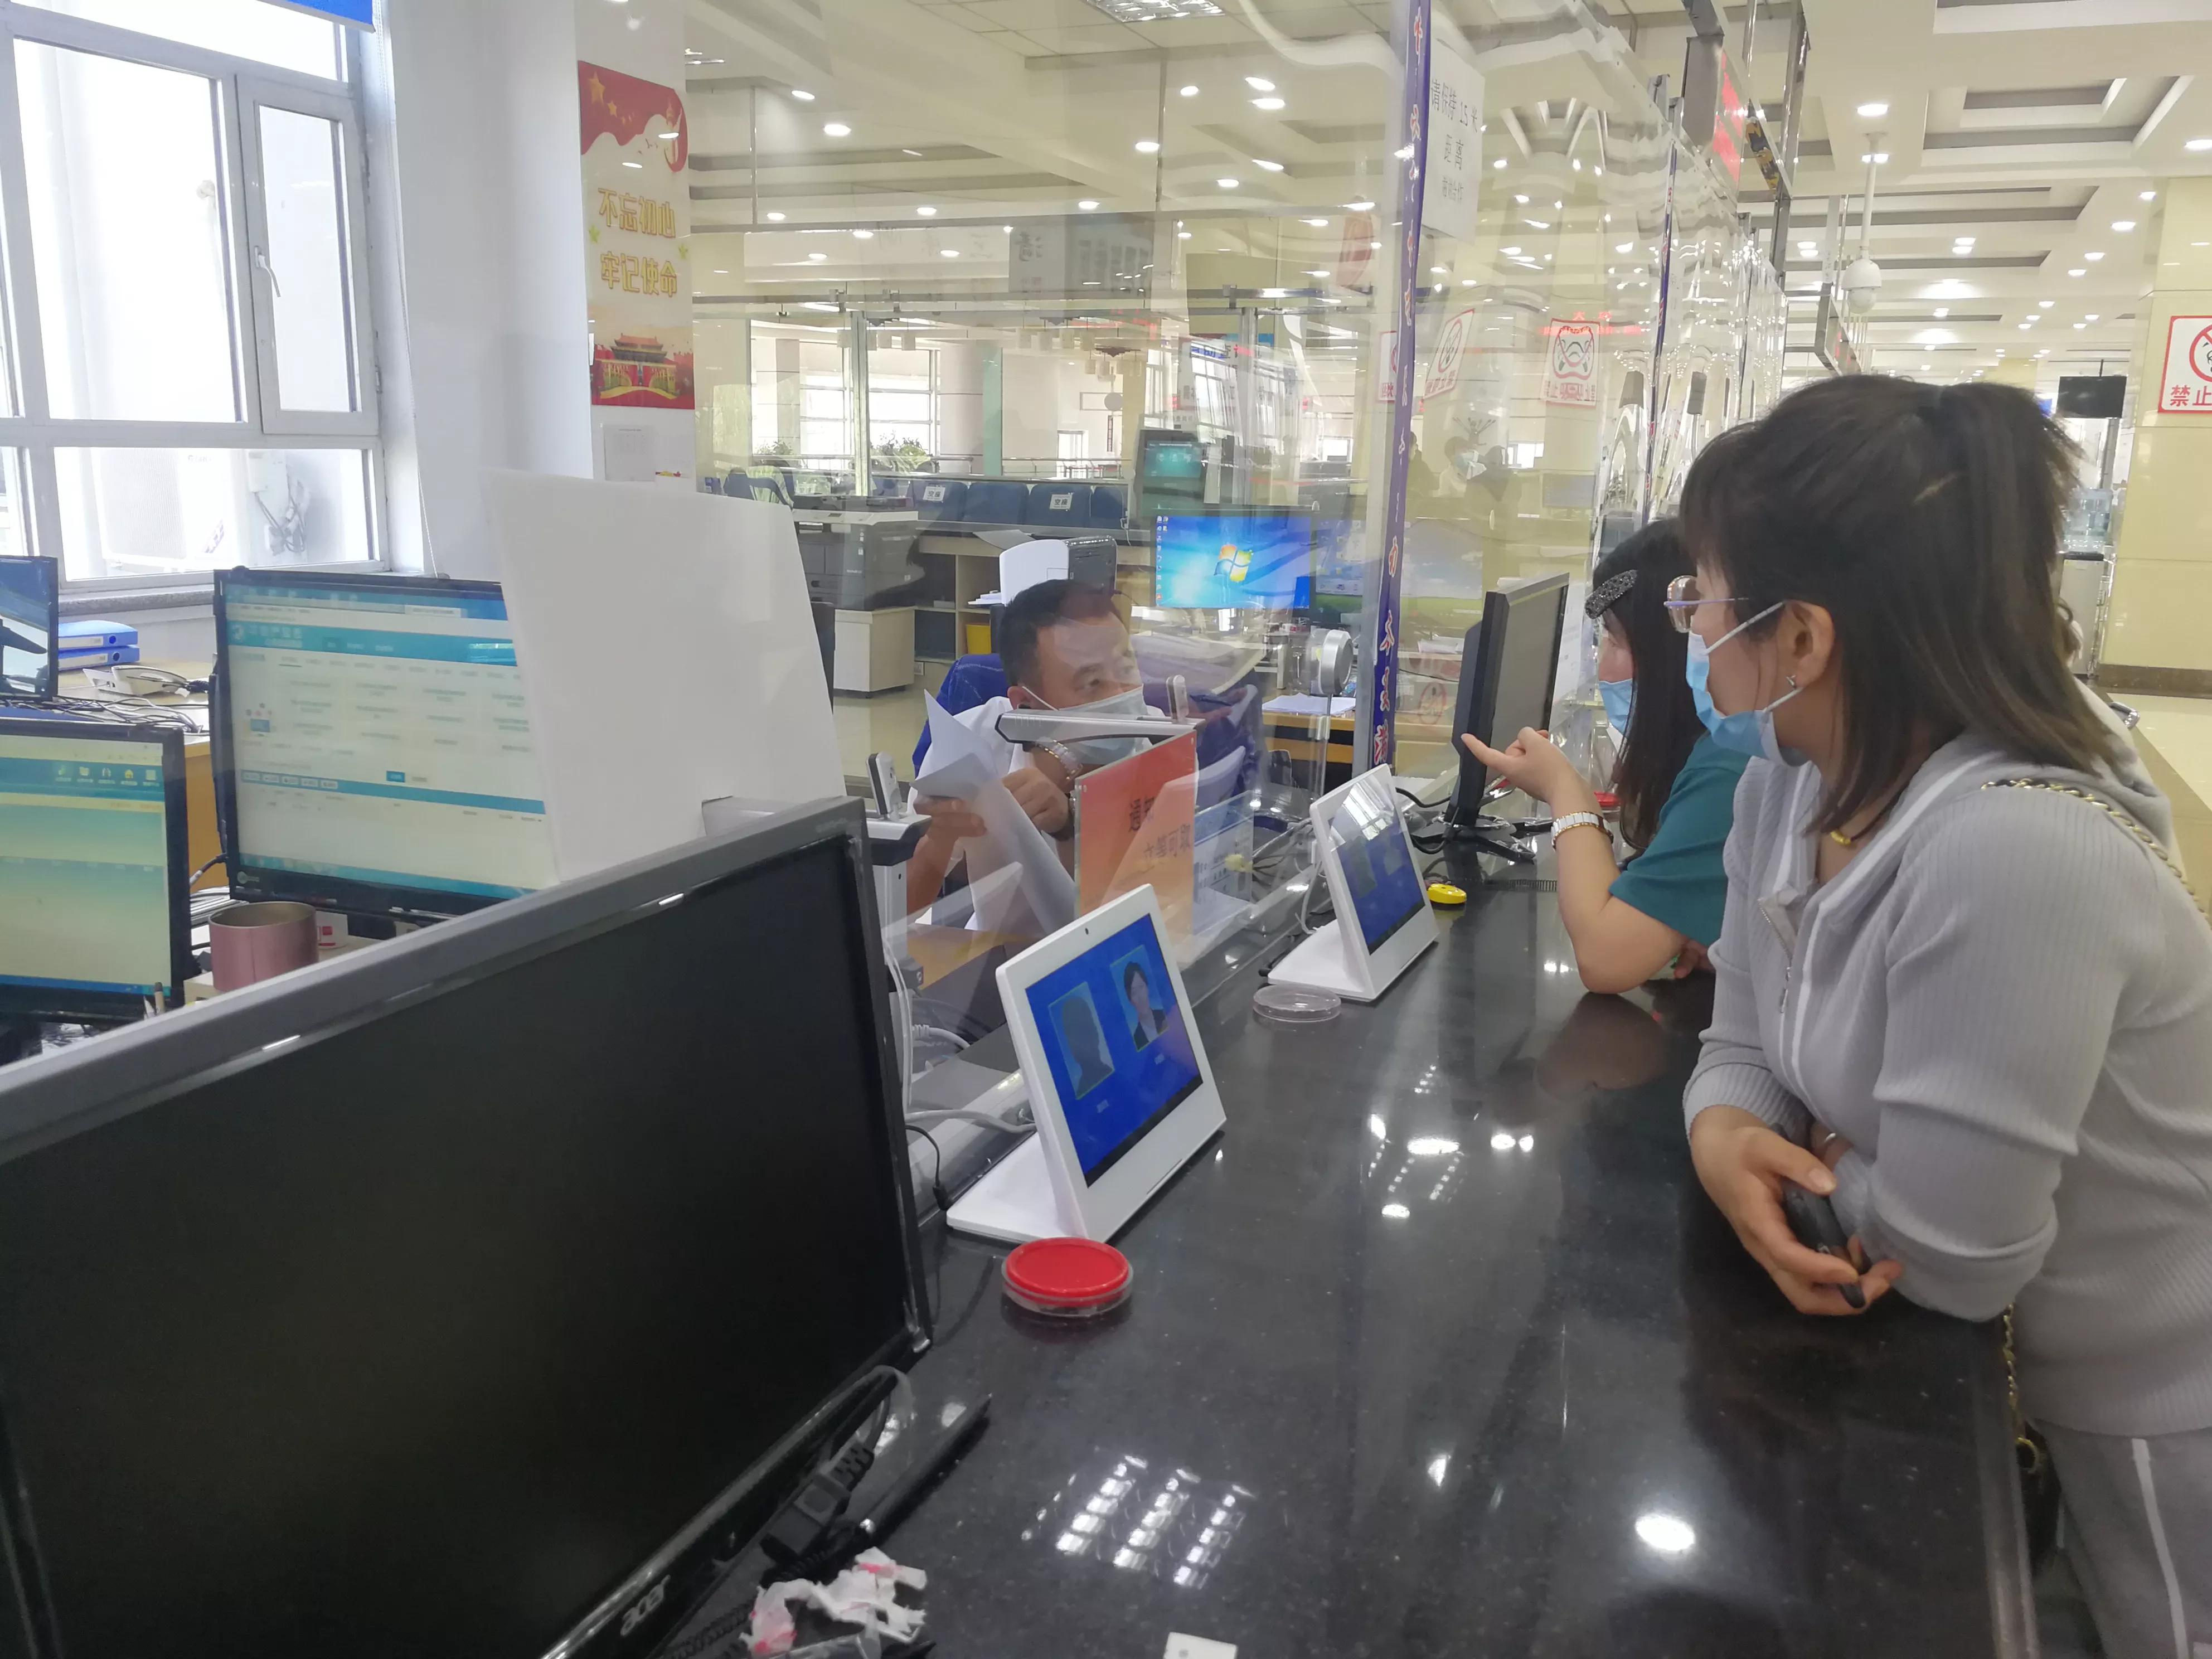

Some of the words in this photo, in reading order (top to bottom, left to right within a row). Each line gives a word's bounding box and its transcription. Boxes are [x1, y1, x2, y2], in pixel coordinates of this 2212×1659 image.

[598, 187, 676, 239] 不忘初心
[600, 251, 677, 297] 牢记使命
[2170, 385, 2212, 407] 禁止
[620, 1574, 671, 1638] acer
